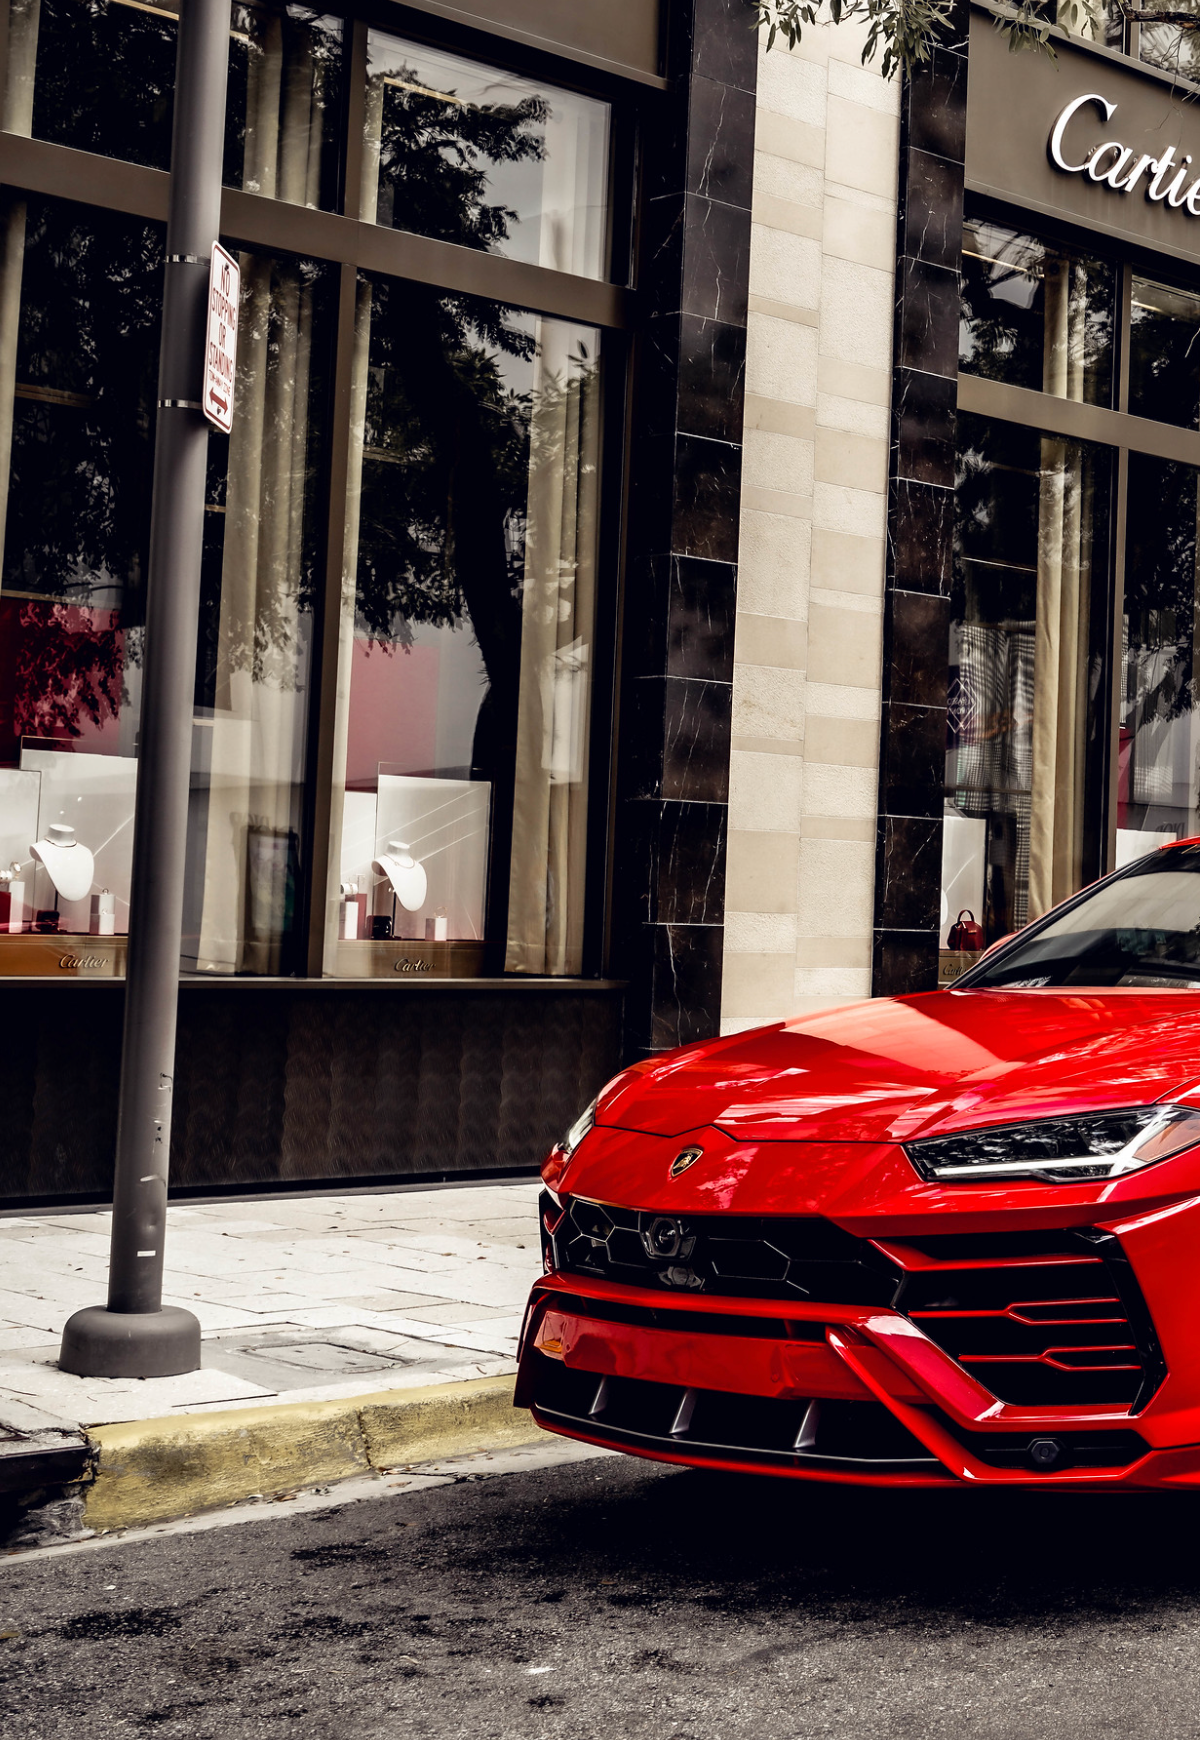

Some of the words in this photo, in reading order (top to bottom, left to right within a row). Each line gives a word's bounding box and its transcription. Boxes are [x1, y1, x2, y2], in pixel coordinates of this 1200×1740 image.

[221, 265, 231, 297] NO
[211, 287, 236, 331] STOPPING
[218, 322, 227, 350] OR
[208, 342, 233, 383] STANDING
[59, 953, 110, 969] Cartier
[394, 958, 437, 972] Cartier
